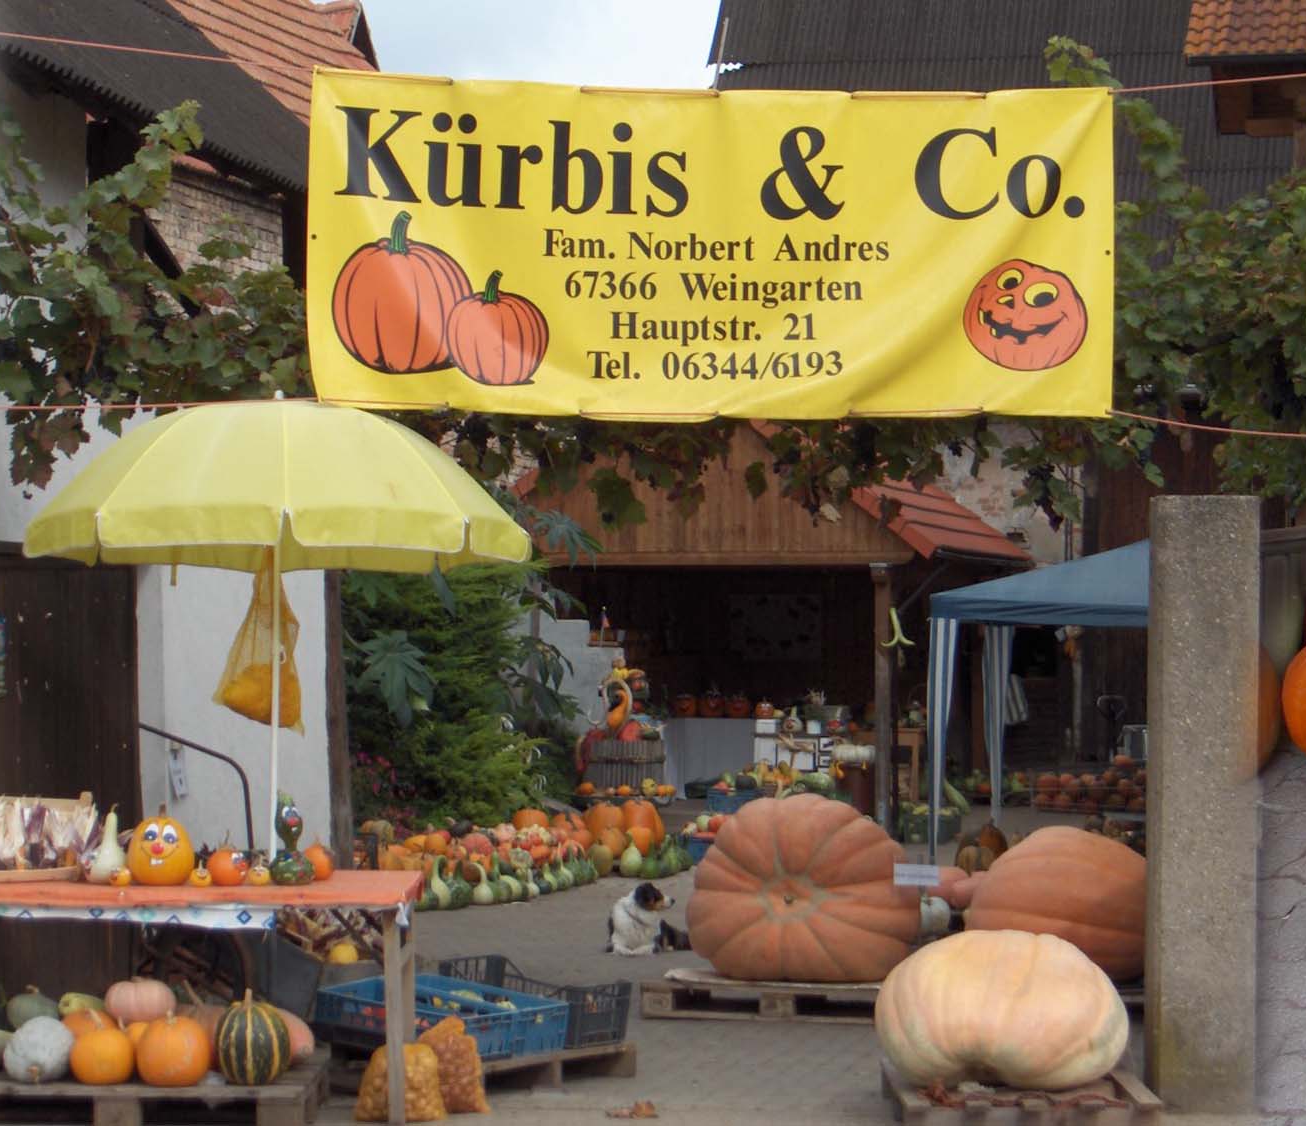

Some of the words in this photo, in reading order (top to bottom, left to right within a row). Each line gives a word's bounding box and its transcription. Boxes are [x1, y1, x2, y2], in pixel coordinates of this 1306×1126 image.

[334, 105, 690, 218] Kürbis
[759, 125, 845, 221] &
[914, 126, 1086, 221] Co.
[542, 228, 616, 260] Fam.
[627, 231, 755, 261] Norbert
[773, 233, 890, 262] Andres
[565, 270, 659, 300] 67366
[679, 272, 863, 310] Weingarten
[610, 311, 762, 347] Hauptstr.
[783, 312, 817, 341] 21
[587, 350, 641, 380] Tel.
[661, 350, 844, 381] 06344/6193
